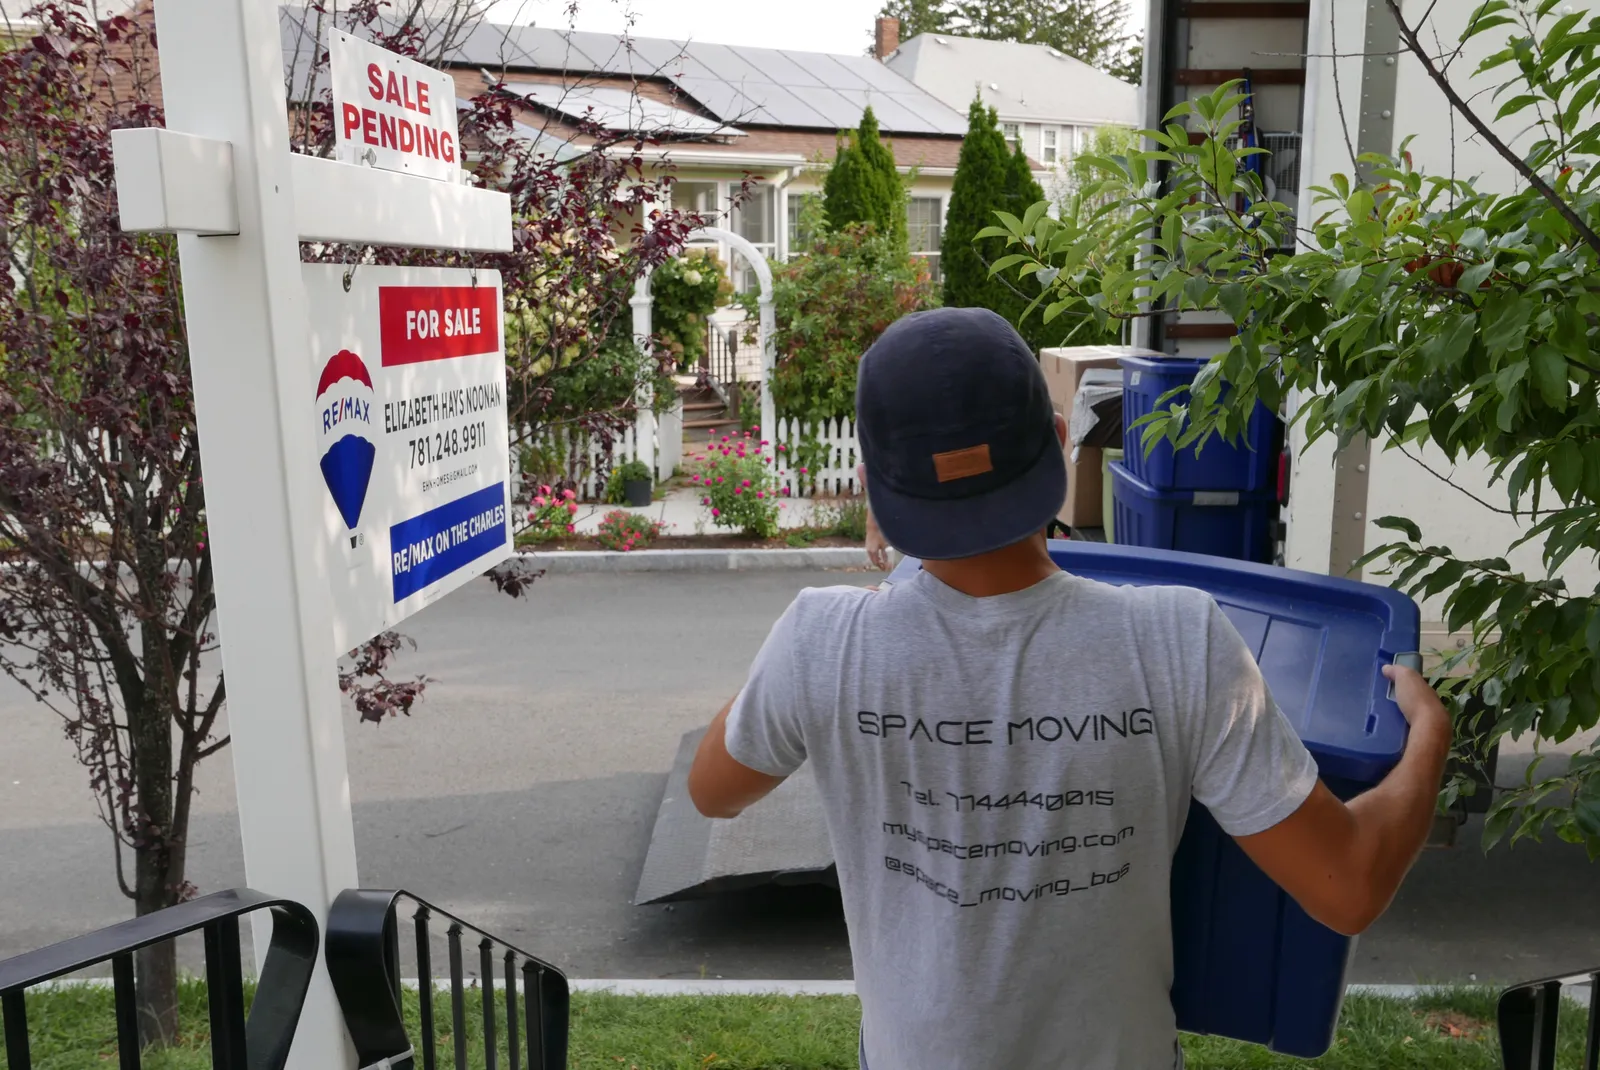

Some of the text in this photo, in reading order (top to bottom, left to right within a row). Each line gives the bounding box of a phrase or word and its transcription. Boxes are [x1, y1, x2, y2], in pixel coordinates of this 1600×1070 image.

[367, 62, 431, 116] SALE
[342, 102, 455, 164] PENDING
[406, 307, 481, 340] FOR SALE
[323, 396, 371, 435] RE/MAX
[384, 382, 501, 434] ELIZABETH HAYS NOONAN
[409, 421, 486, 469] 781.248.9911
[393, 504, 504, 575] RE/MAX ON THE CHARLES
[857, 707, 1153, 745] SPACE MOVING
[900, 781, 1114, 811] Tel. 7744440015
[882, 821, 1134, 859] myspacemoving.com
[884, 856, 1131, 907] @space_moving_bos
